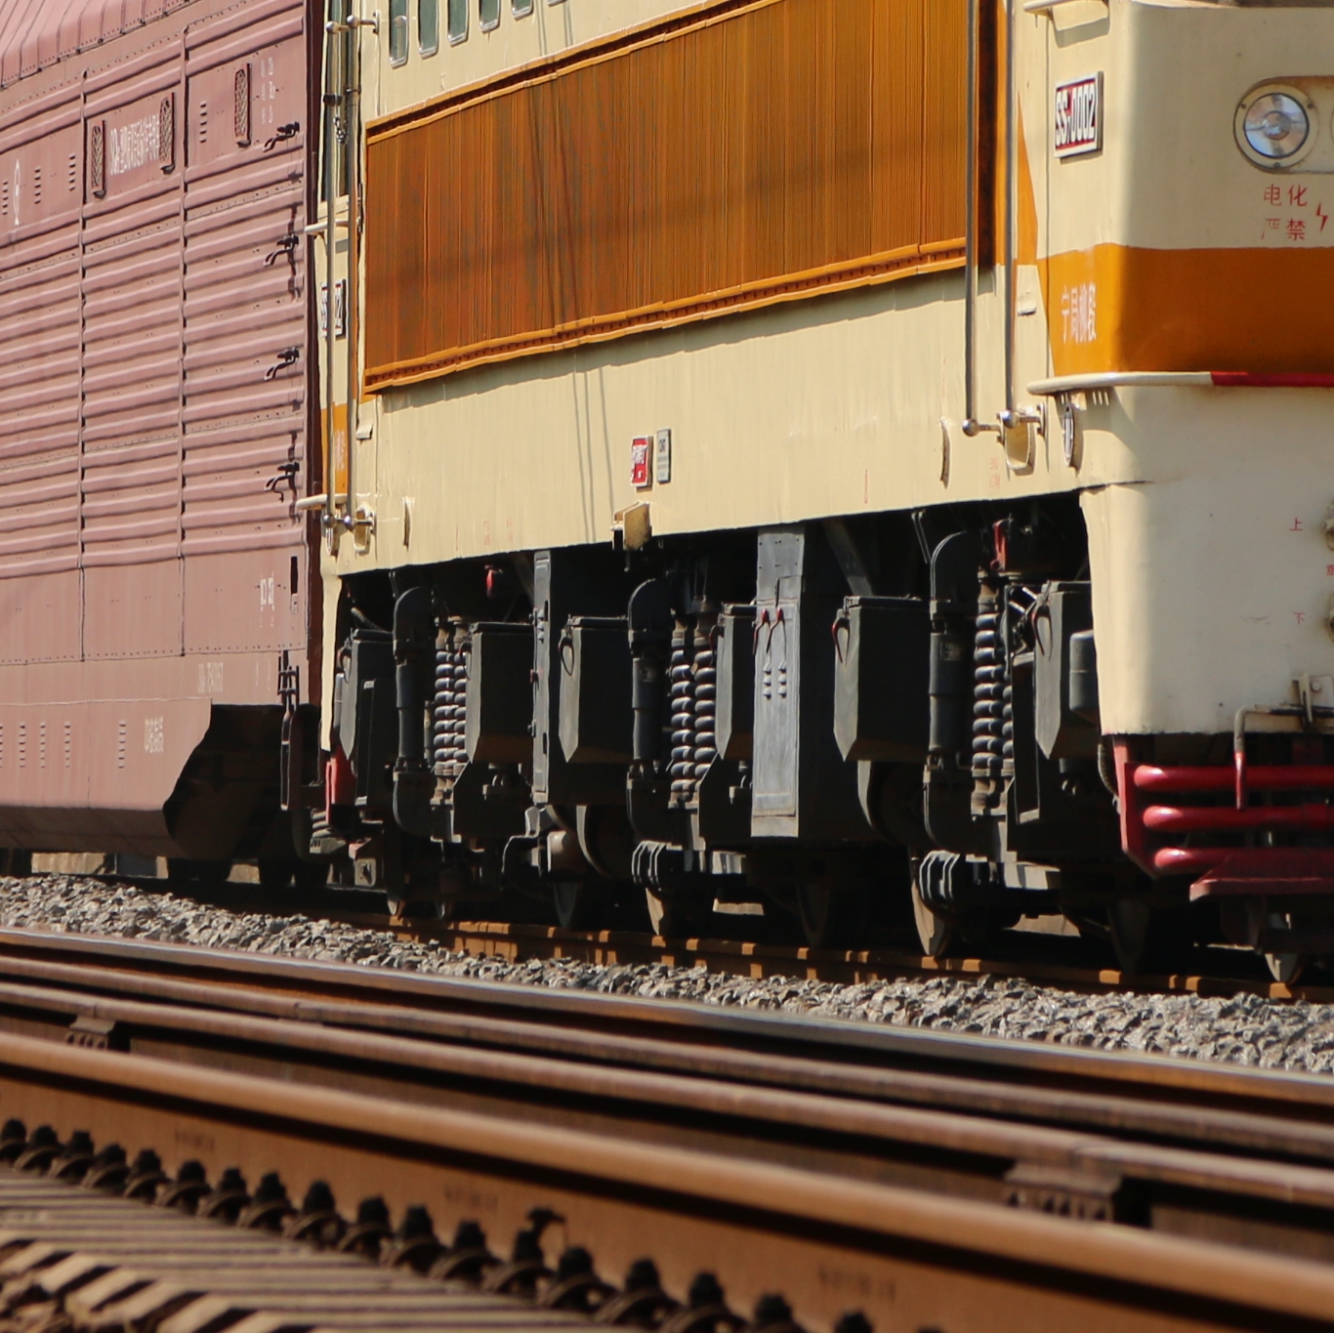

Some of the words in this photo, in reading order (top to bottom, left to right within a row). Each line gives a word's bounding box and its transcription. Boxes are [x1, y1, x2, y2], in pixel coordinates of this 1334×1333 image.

[1263, 183, 1307, 207] 电化
[1289, 517, 1303, 532] 上
[1293, 612, 1305, 626] 下
